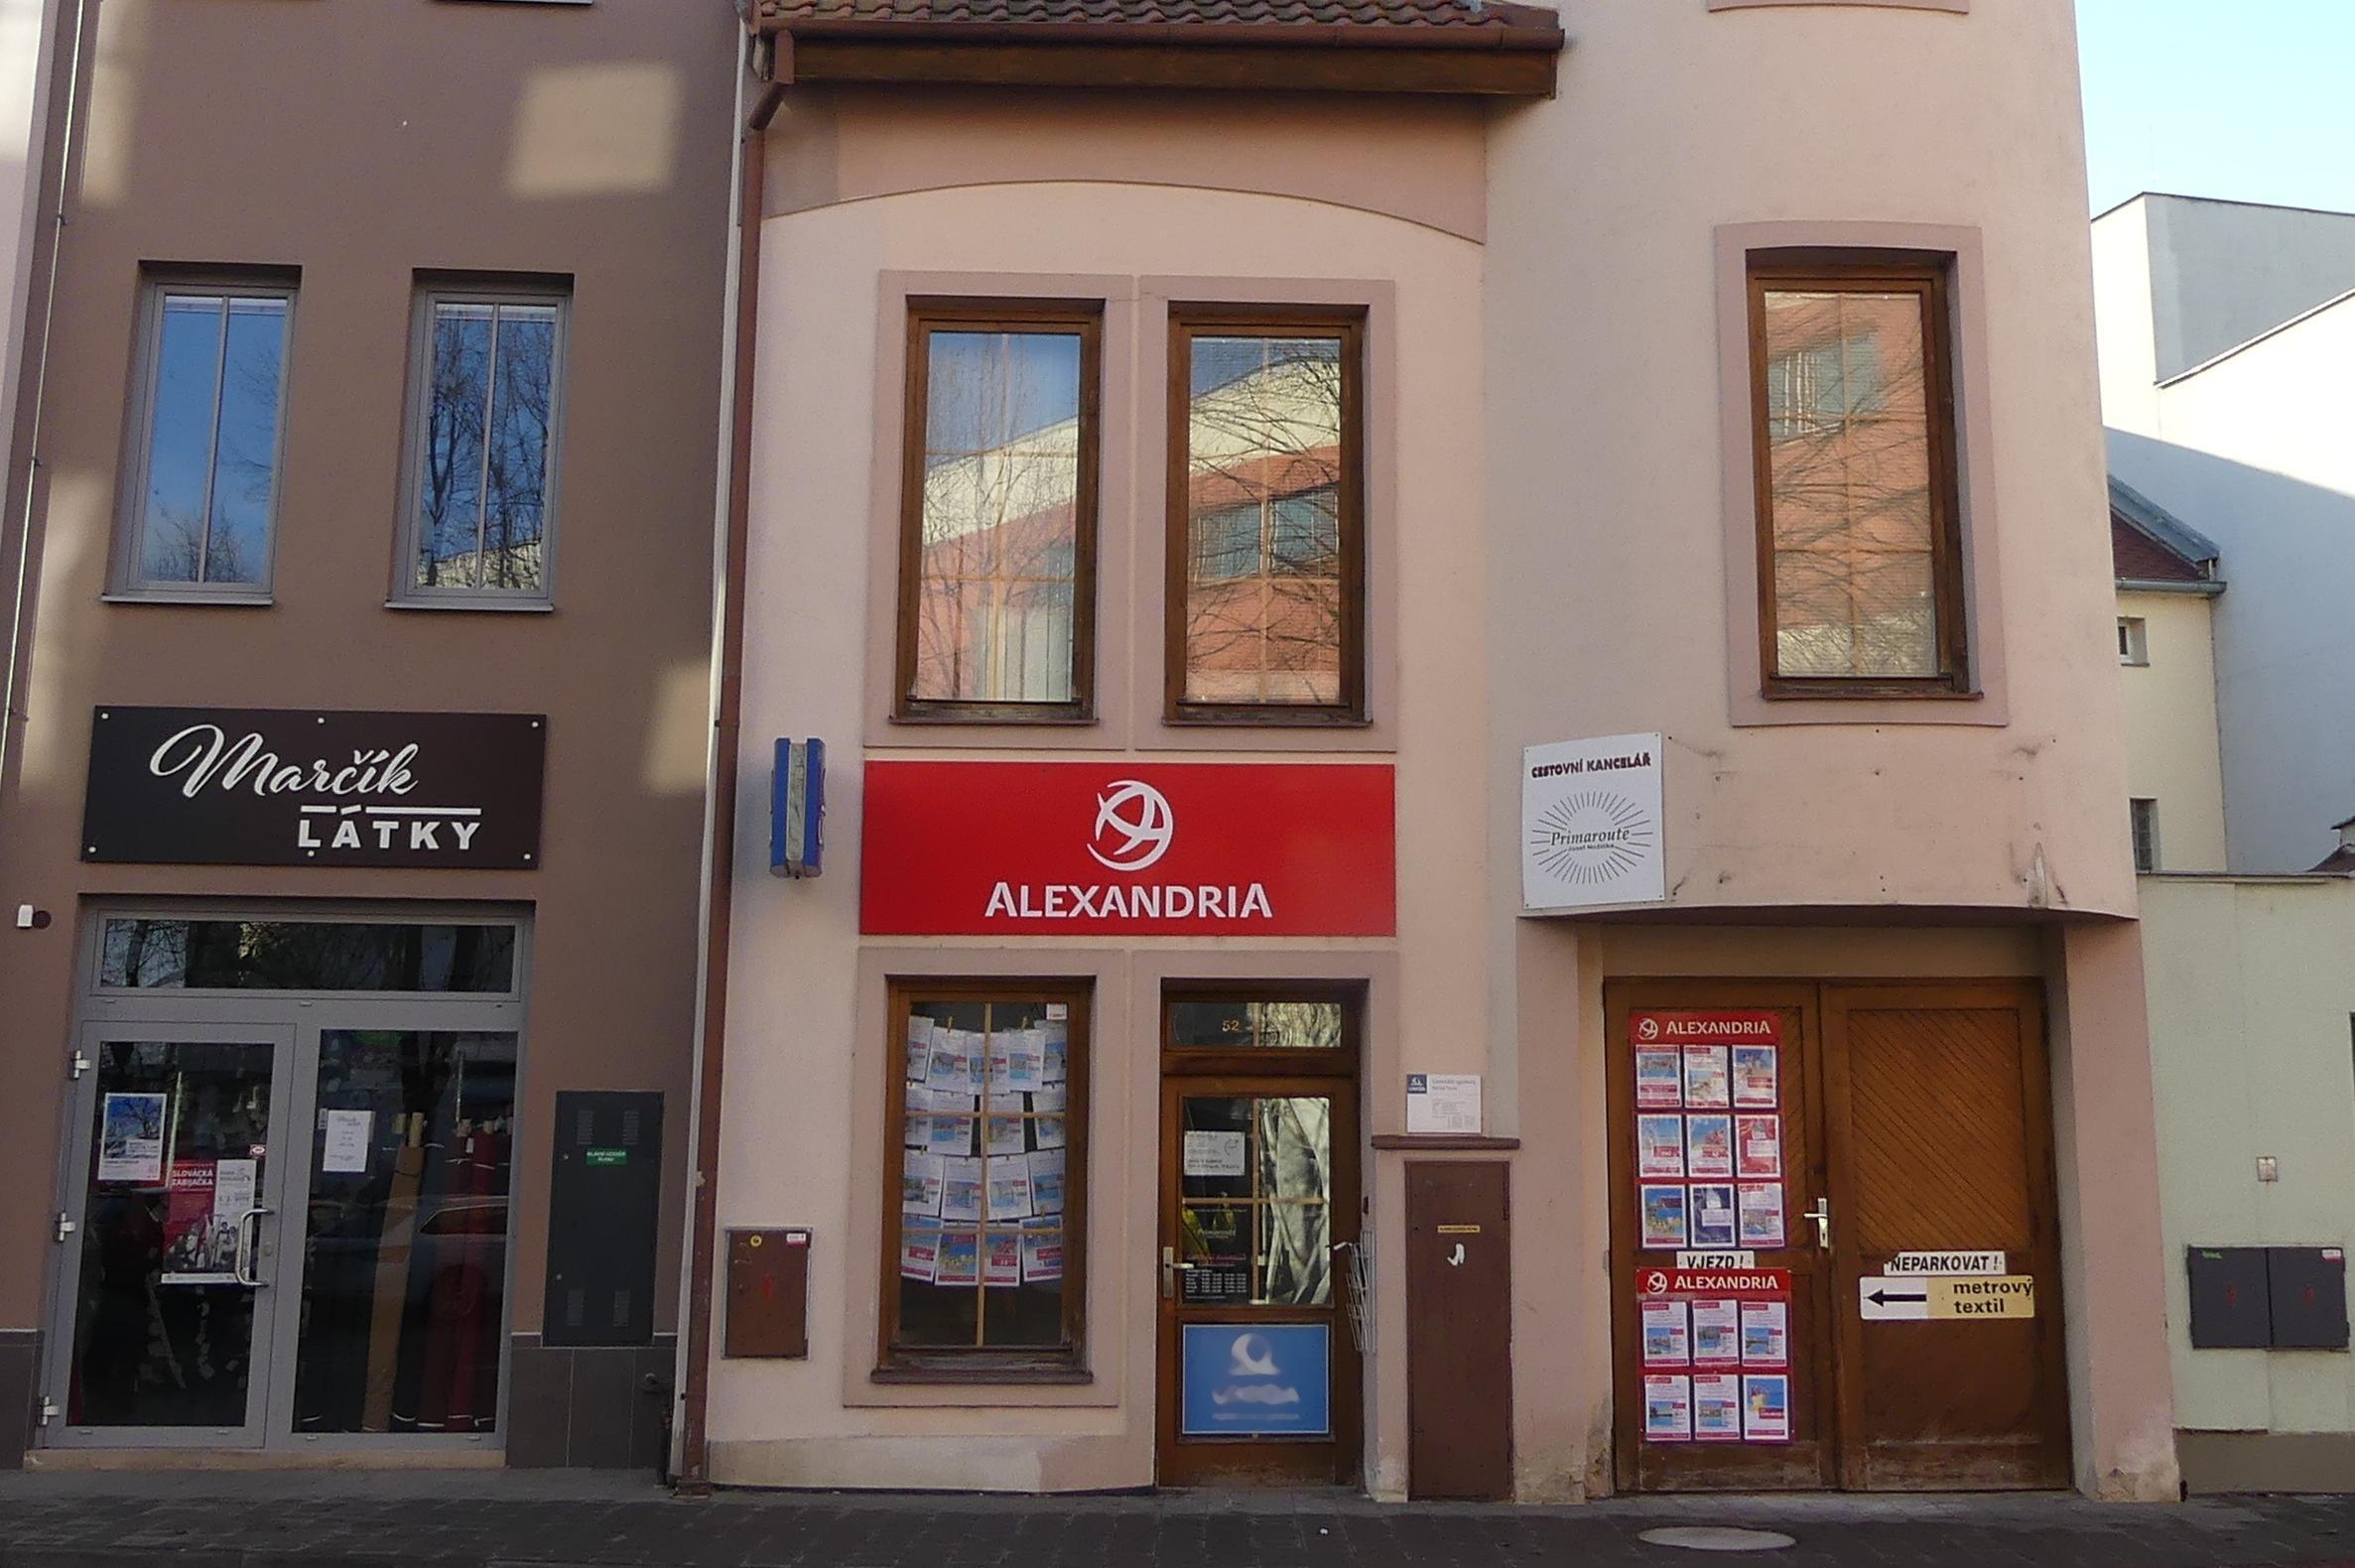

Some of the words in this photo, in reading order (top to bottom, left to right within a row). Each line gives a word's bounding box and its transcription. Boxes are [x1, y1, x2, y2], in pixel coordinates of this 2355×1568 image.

[149, 724, 419, 798] Marčík
[1531, 758, 1584, 778] CESTOVNÍ
[1587, 752, 1651, 773] KANCELÁŘ
[298, 805, 481, 850] LÁTKY
[1551, 827, 1631, 847] Primaroute
[984, 881, 1273, 919] ALEXANDRIA
[1223, 1020, 1240, 1032] 52
[1665, 1020, 1771, 1035] ALEXANDRIA
[1687, 1254, 1735, 1268] VJEZD
[1891, 1255, 1990, 1272] NEPARKOVAT
[1674, 1275, 1779, 1289] ALEXANDRIA
[1952, 1278, 2034, 1297] metrový
[1954, 1298, 2006, 1314] textil
